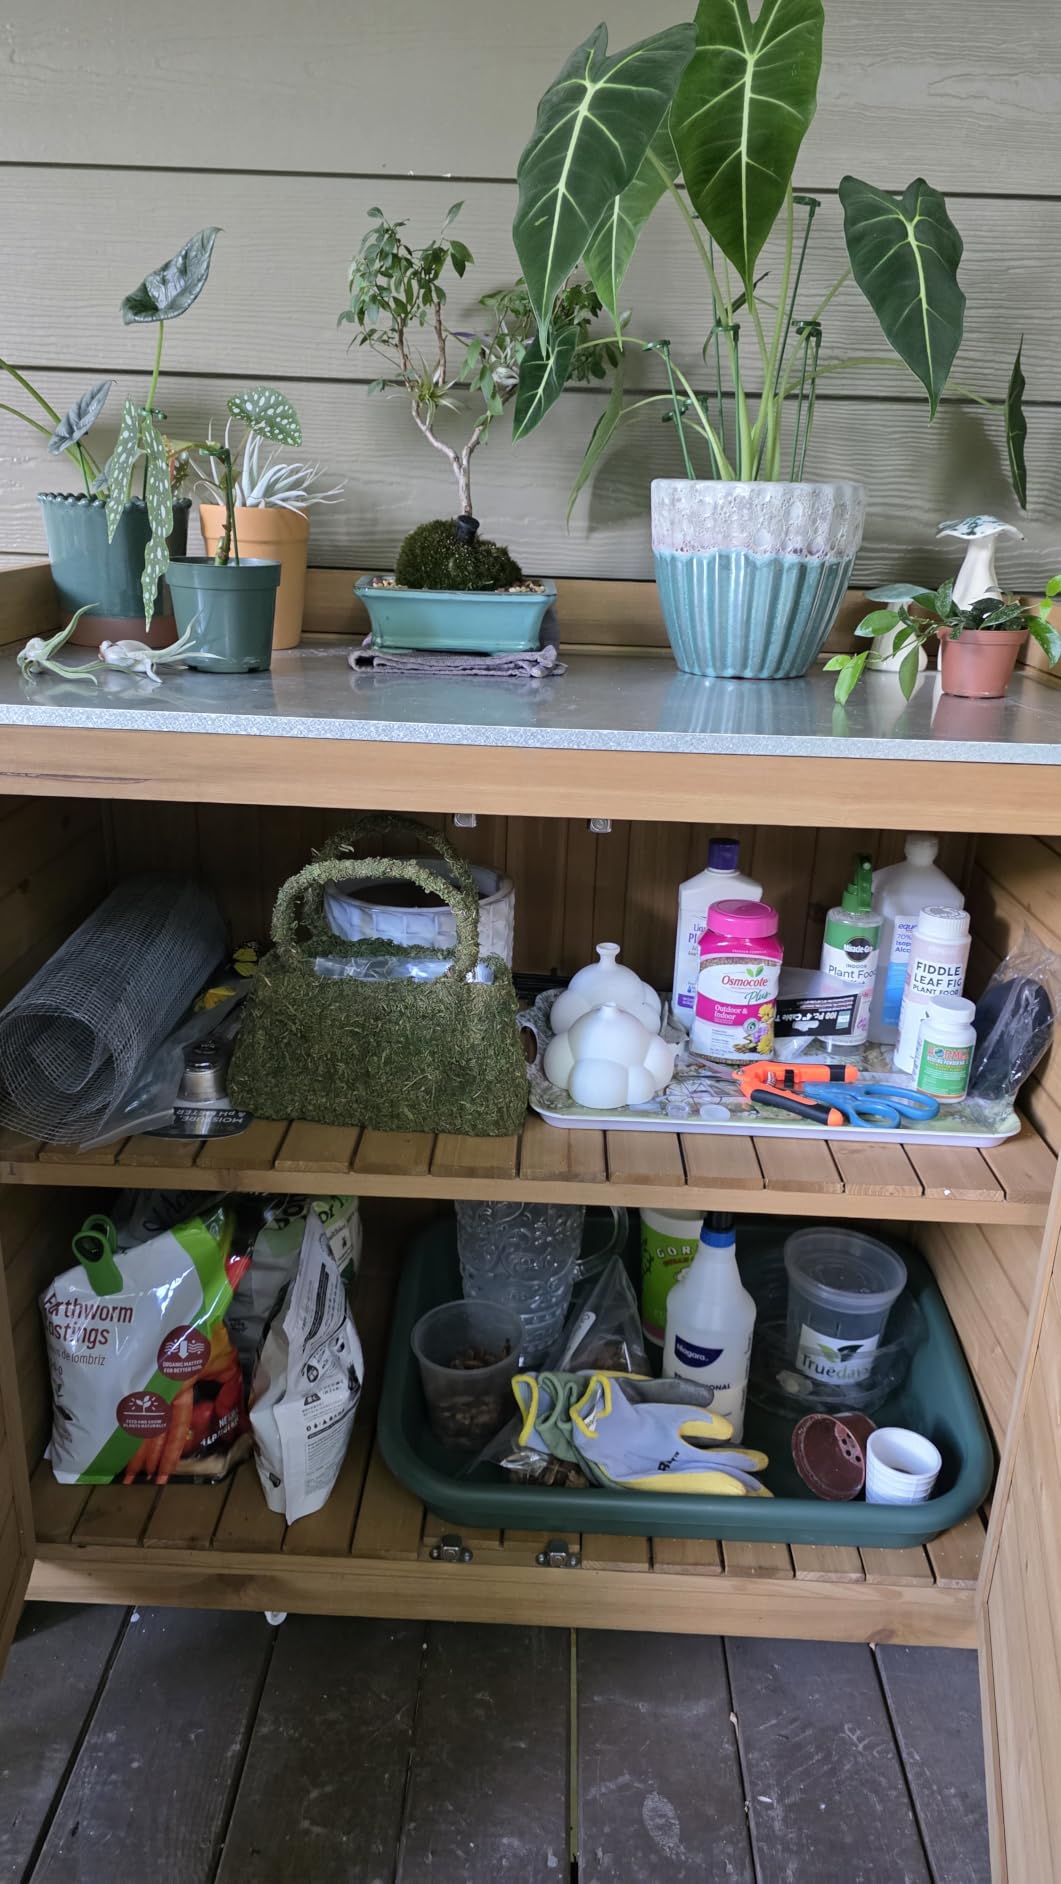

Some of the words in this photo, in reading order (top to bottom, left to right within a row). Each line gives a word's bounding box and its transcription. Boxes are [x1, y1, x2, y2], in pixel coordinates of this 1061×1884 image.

[828, 965, 854, 979] Plant
[916, 961, 961, 976] FIDDLE
[721, 975, 768, 987] Osmocote
[914, 972, 943, 987] LEAF
[912, 983, 937, 995] PLANT
[744, 989, 771, 1005] Plus
[714, 1004, 741, 1014] Outdoor
[714, 1011, 736, 1020] Indoor
[71, 1353, 106, 1366] lombriz
